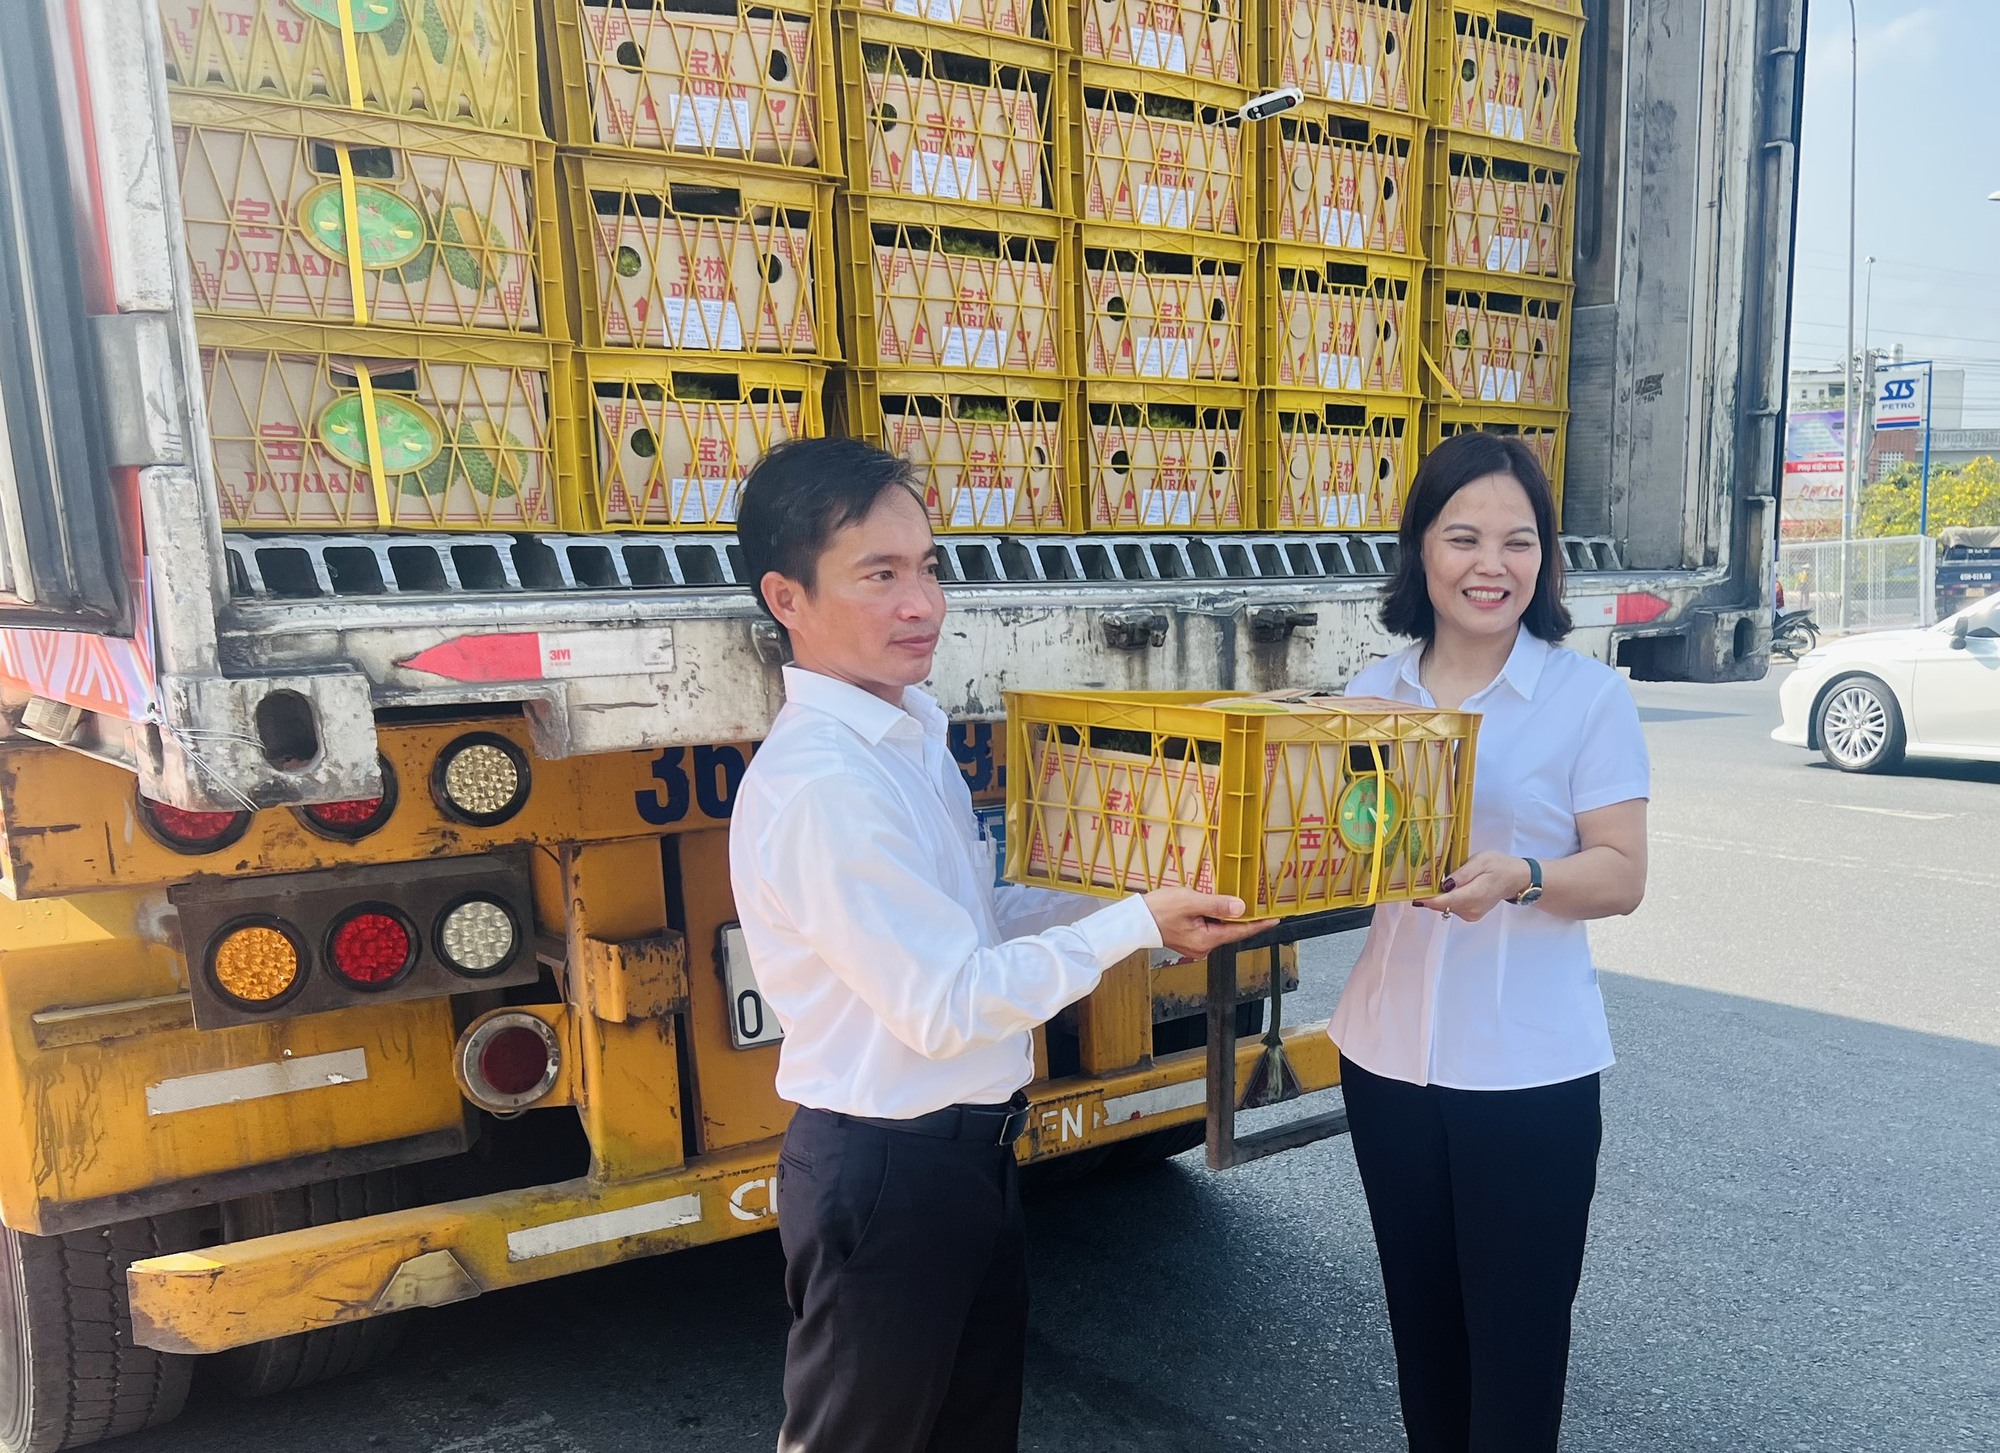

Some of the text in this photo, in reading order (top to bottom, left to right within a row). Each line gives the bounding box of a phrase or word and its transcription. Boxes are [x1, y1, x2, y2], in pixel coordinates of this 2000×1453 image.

[245, 471, 365, 494] DURIAN
[549, 649, 571, 661] 3M
[632, 741, 762, 826] 36
